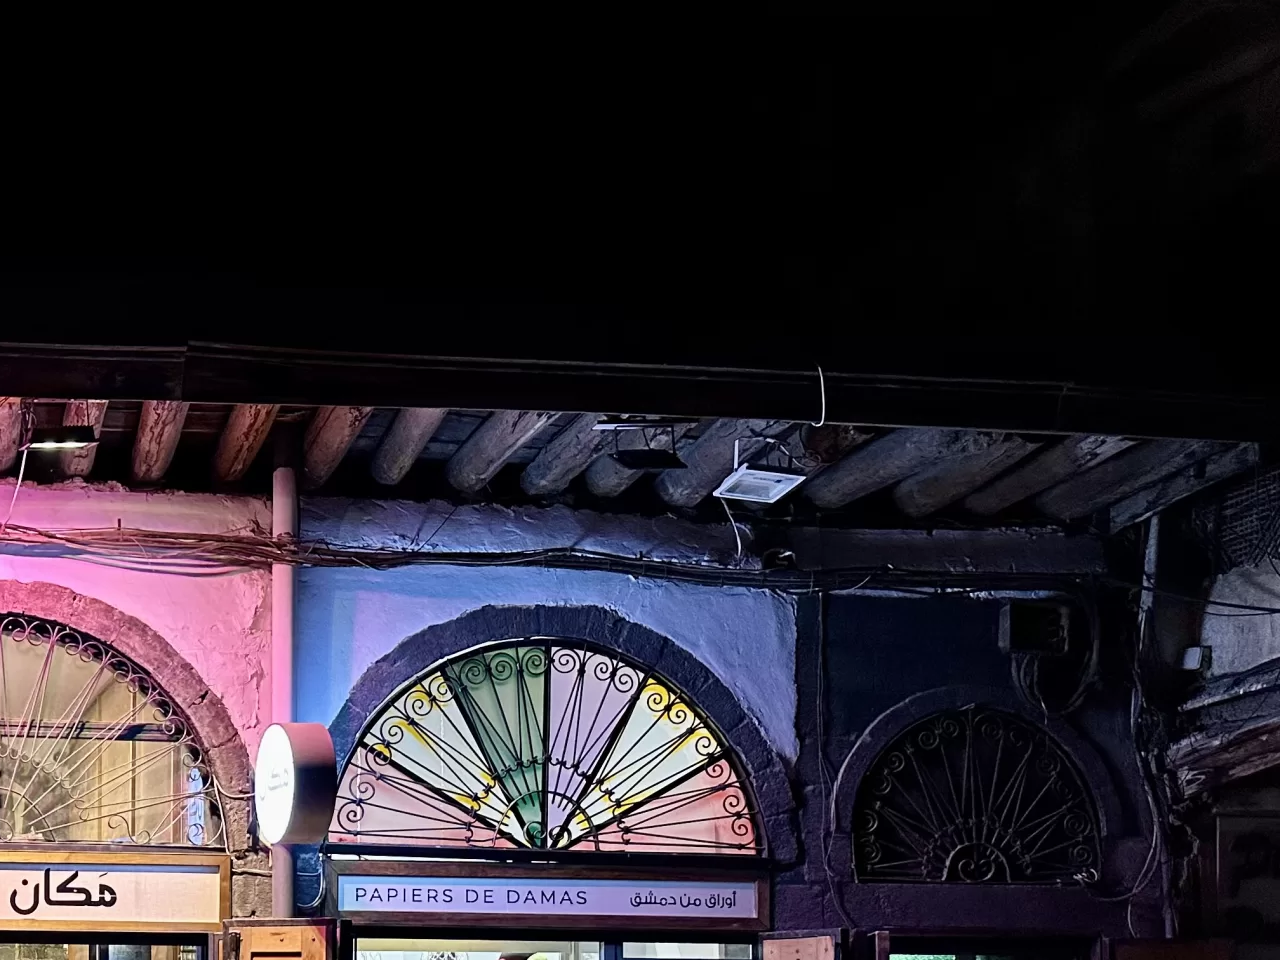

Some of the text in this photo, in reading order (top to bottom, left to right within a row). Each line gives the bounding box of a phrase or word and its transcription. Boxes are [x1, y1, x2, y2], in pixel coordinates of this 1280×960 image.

[355, 887, 588, 905] PAPIERS DE DAMAS
[630, 890, 737, 909] أوراق من دمشق
